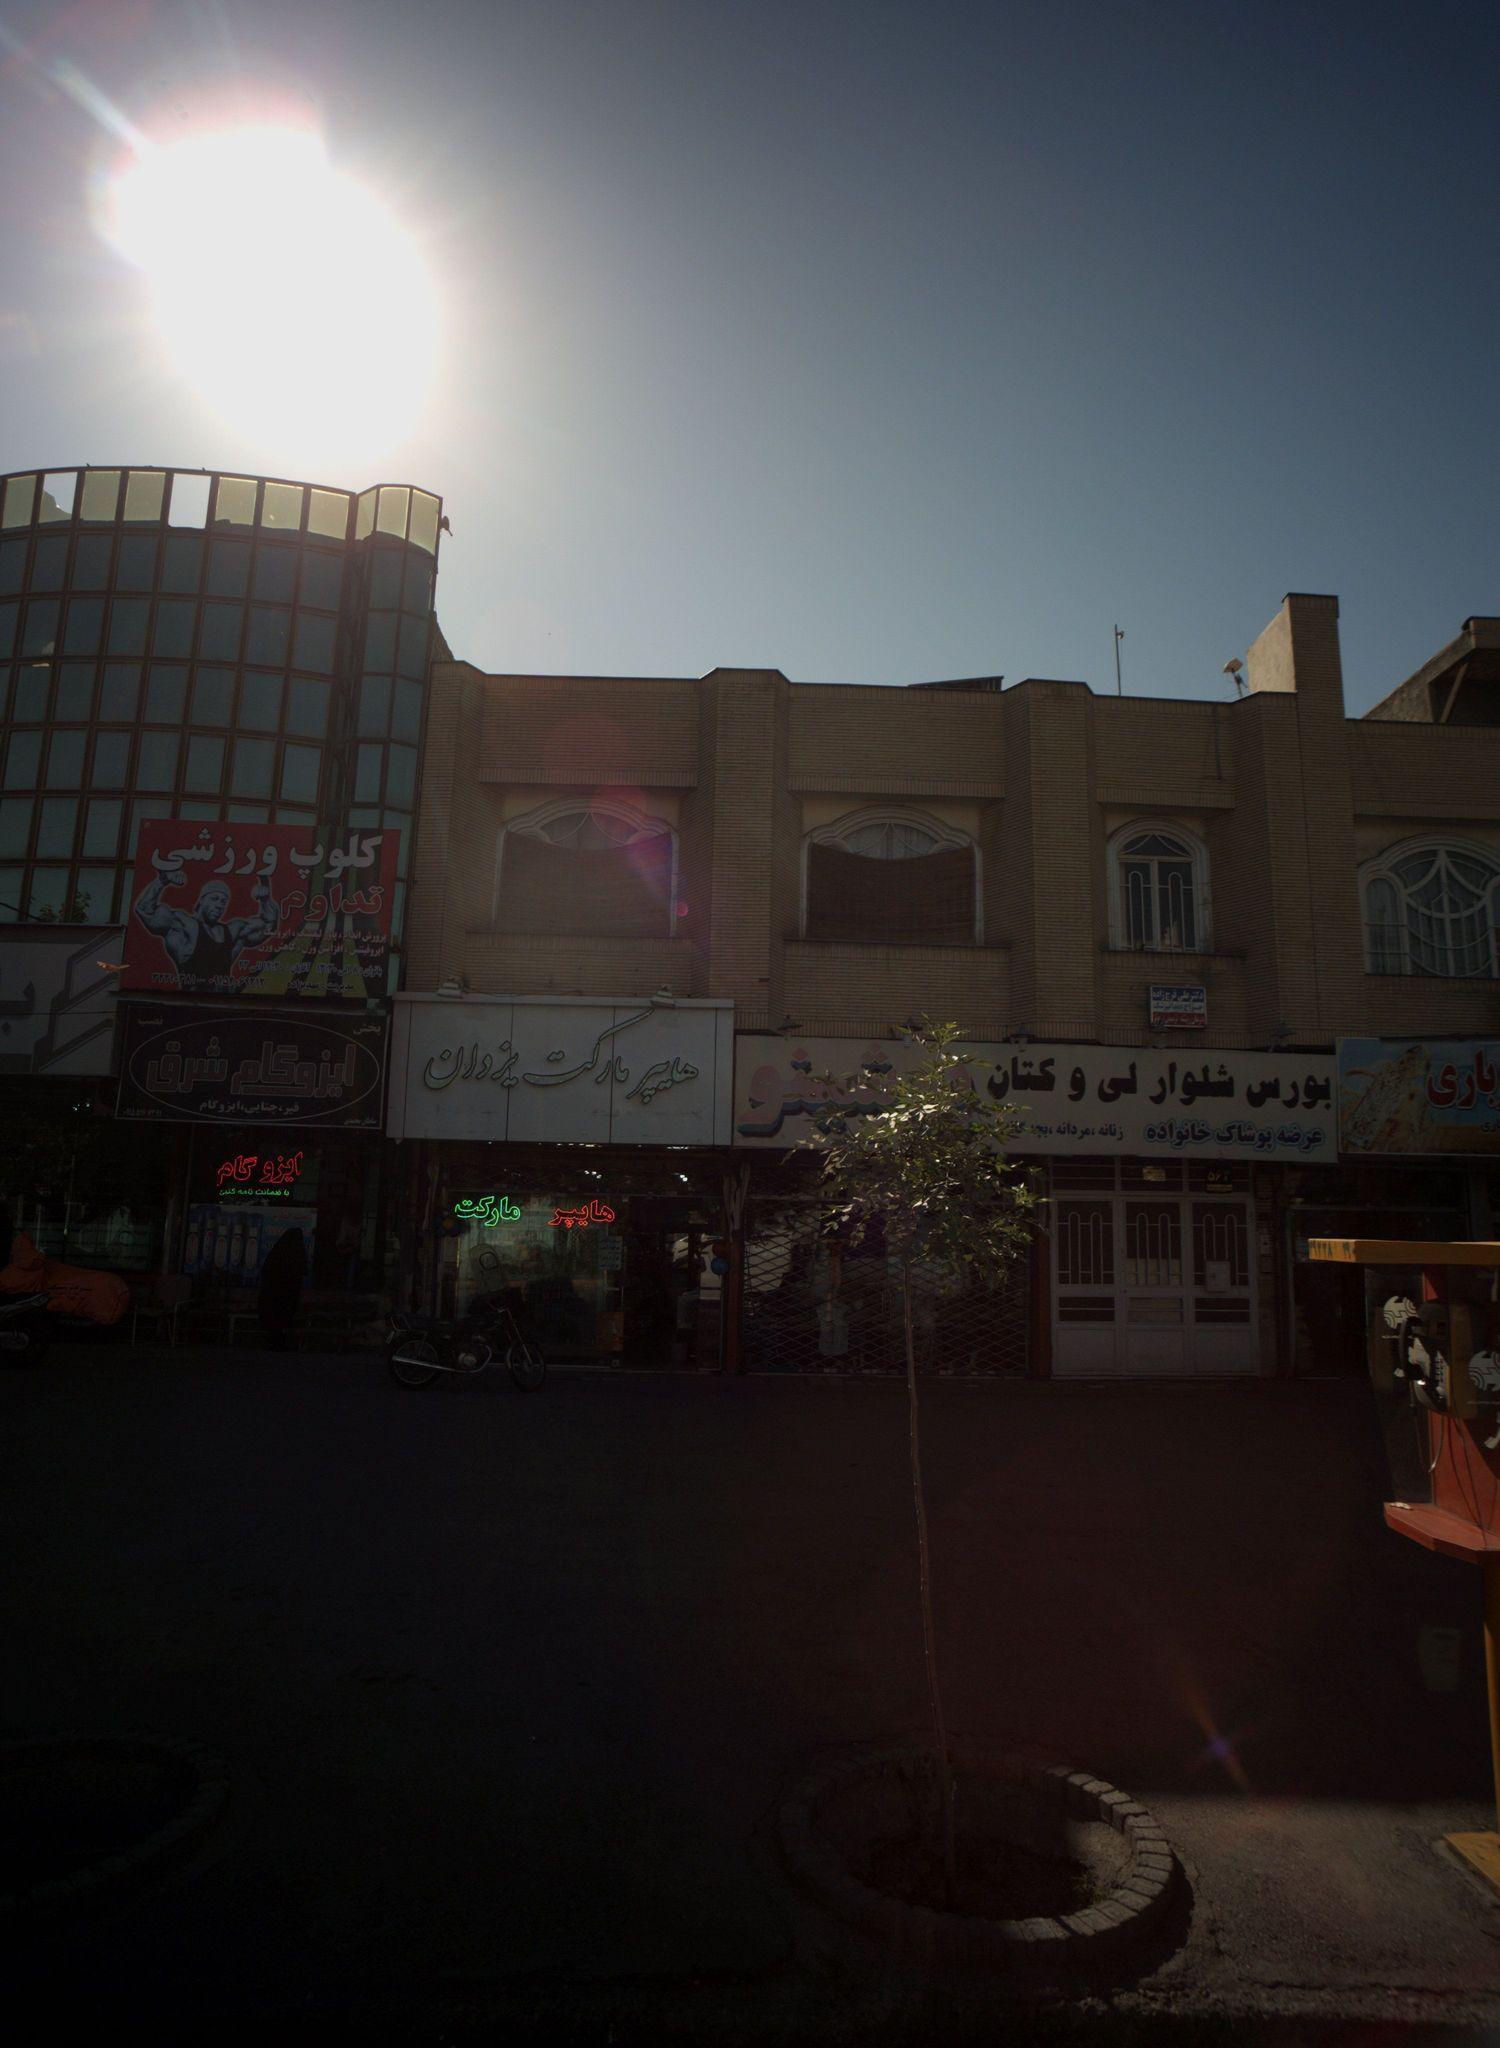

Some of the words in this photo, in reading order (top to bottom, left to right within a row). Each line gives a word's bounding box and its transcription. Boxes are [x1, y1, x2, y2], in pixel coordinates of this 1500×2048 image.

[150, 827, 278, 877] ورزشی
[289, 834, 384, 880] کلوپ
[280, 883, 385, 921] تداوم
[144, 1035, 230, 1093] شرق
[423, 1040, 520, 1090] یزدان
[522, 1008, 656, 1086] مارکت
[230, 1040, 357, 1097] ایزوگام
[627, 1057, 699, 1104] هایپر
[986, 1056, 1057, 1101] کتان
[1067, 1065, 1087, 1103] و
[1096, 1062, 1138, 1103] لی
[1149, 1061, 1236, 1106] شلوار
[1245, 1072, 1331, 1110] بورس
[1145, 1119, 1210, 1149] خانواده
[1217, 1120, 1274, 1151] پوشاک
[1277, 1123, 1325, 1153] عرضه
[217, 1154, 259, 1185] گام
[259, 1151, 304, 1184] ایزو
[454, 1195, 522, 1228] مارکت
[548, 1199, 616, 1229] هایپر
